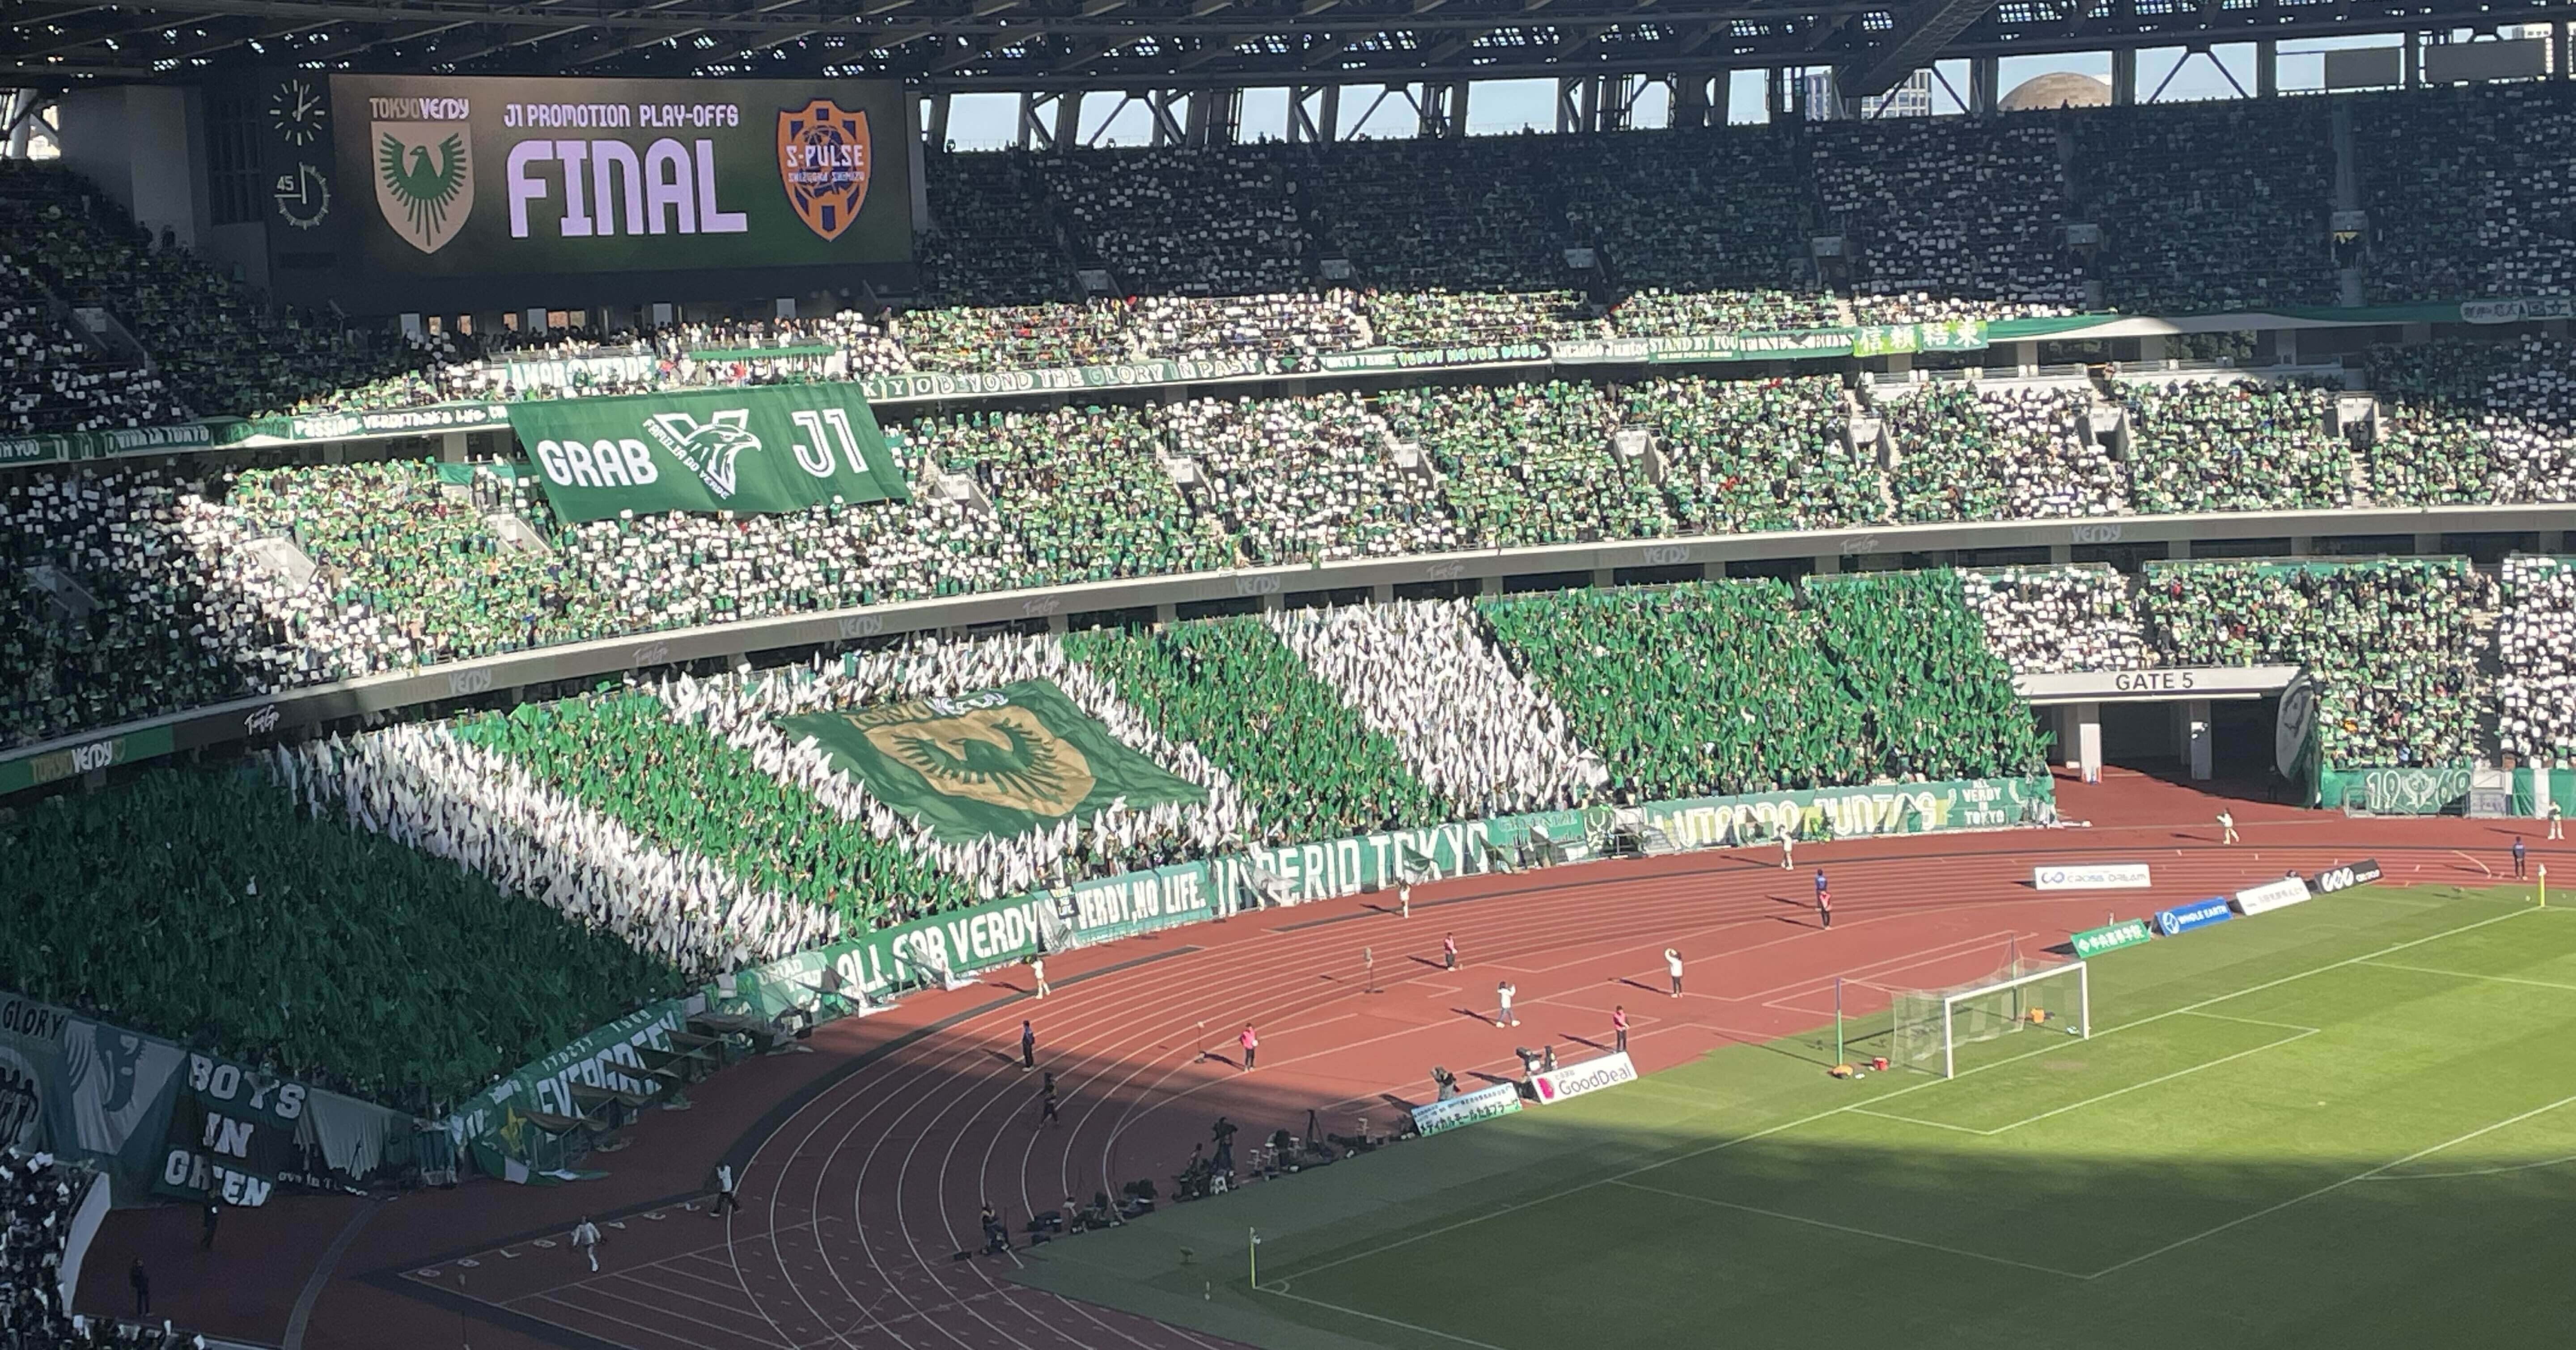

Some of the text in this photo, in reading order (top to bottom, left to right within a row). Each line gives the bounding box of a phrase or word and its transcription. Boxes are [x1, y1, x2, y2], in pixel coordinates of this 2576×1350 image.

[504, 103, 739, 128] J1 PROMOTION PLAY-OFFS
[786, 144, 864, 167] S-PULSE
[276, 175, 294, 191] 45
[506, 138, 748, 238] FINAL
[1649, 336, 1692, 353] STAND
[1712, 335, 1739, 351] YOU
[940, 371, 1033, 394] BEYOND
[1036, 368, 1084, 388] THE
[1088, 364, 1164, 385] GLORY
[1168, 361, 1196, 381] IN
[536, 408, 869, 487] GRAB J1
[2116, 672, 2194, 692] GATE 5
[1962, 787, 2002, 802] VERDY
[1964, 809, 2005, 826] TOKYO
[1368, 823, 1490, 891] TOKYO
[1164, 871, 1207, 914] LIFE.
[947, 900, 1038, 964] VERDY
[3, 999, 65, 1041] GLORY
[189, 1052, 306, 1119] BOYS
[1559, 1063, 1631, 1095] GoodDeal
[203, 1112, 254, 1159] IN
[164, 1149, 271, 1207] GREN
